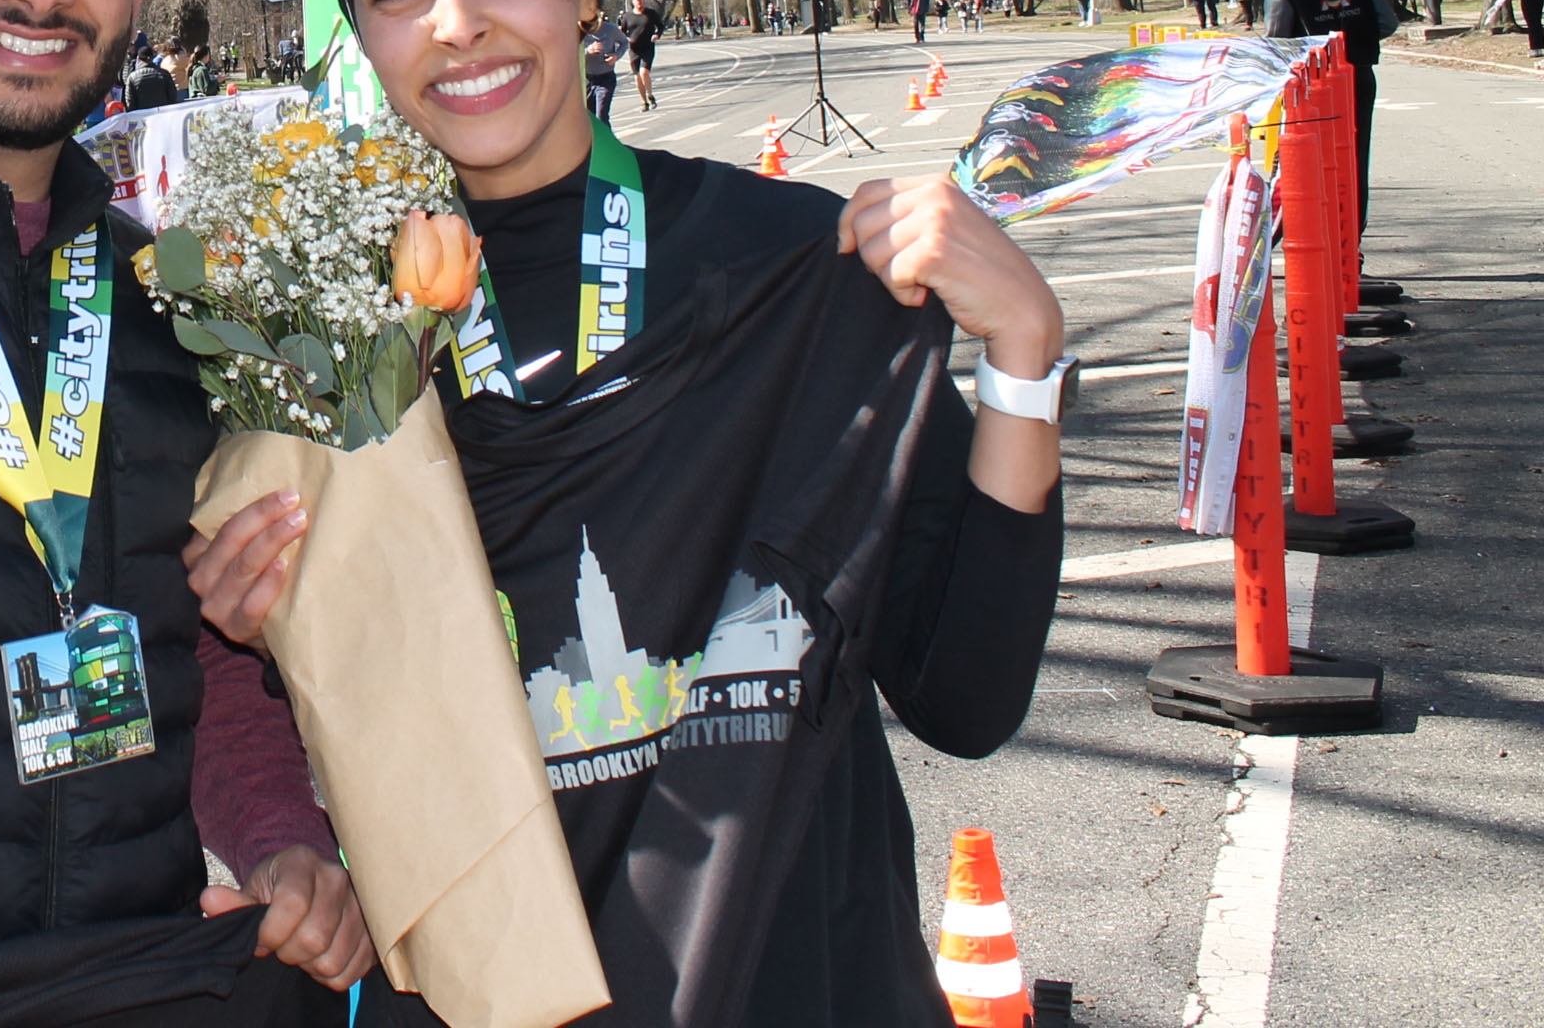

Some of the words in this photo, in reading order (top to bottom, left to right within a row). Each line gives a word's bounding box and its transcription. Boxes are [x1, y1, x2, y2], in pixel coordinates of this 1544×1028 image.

[588, 192, 631, 362] iruns
[1290, 308, 1311, 494] CITYTRI
[726, 680, 769, 710] 10K
[18, 713, 76, 742] BROOKLYN
[20, 735, 48, 758] HALF
[23, 753, 46, 774] 10K
[46, 753, 56, 769] &
[56, 746, 73, 766] 5K
[546, 741, 659, 791] BROOKLYN
[669, 712, 793, 751] CITYTRIRU
